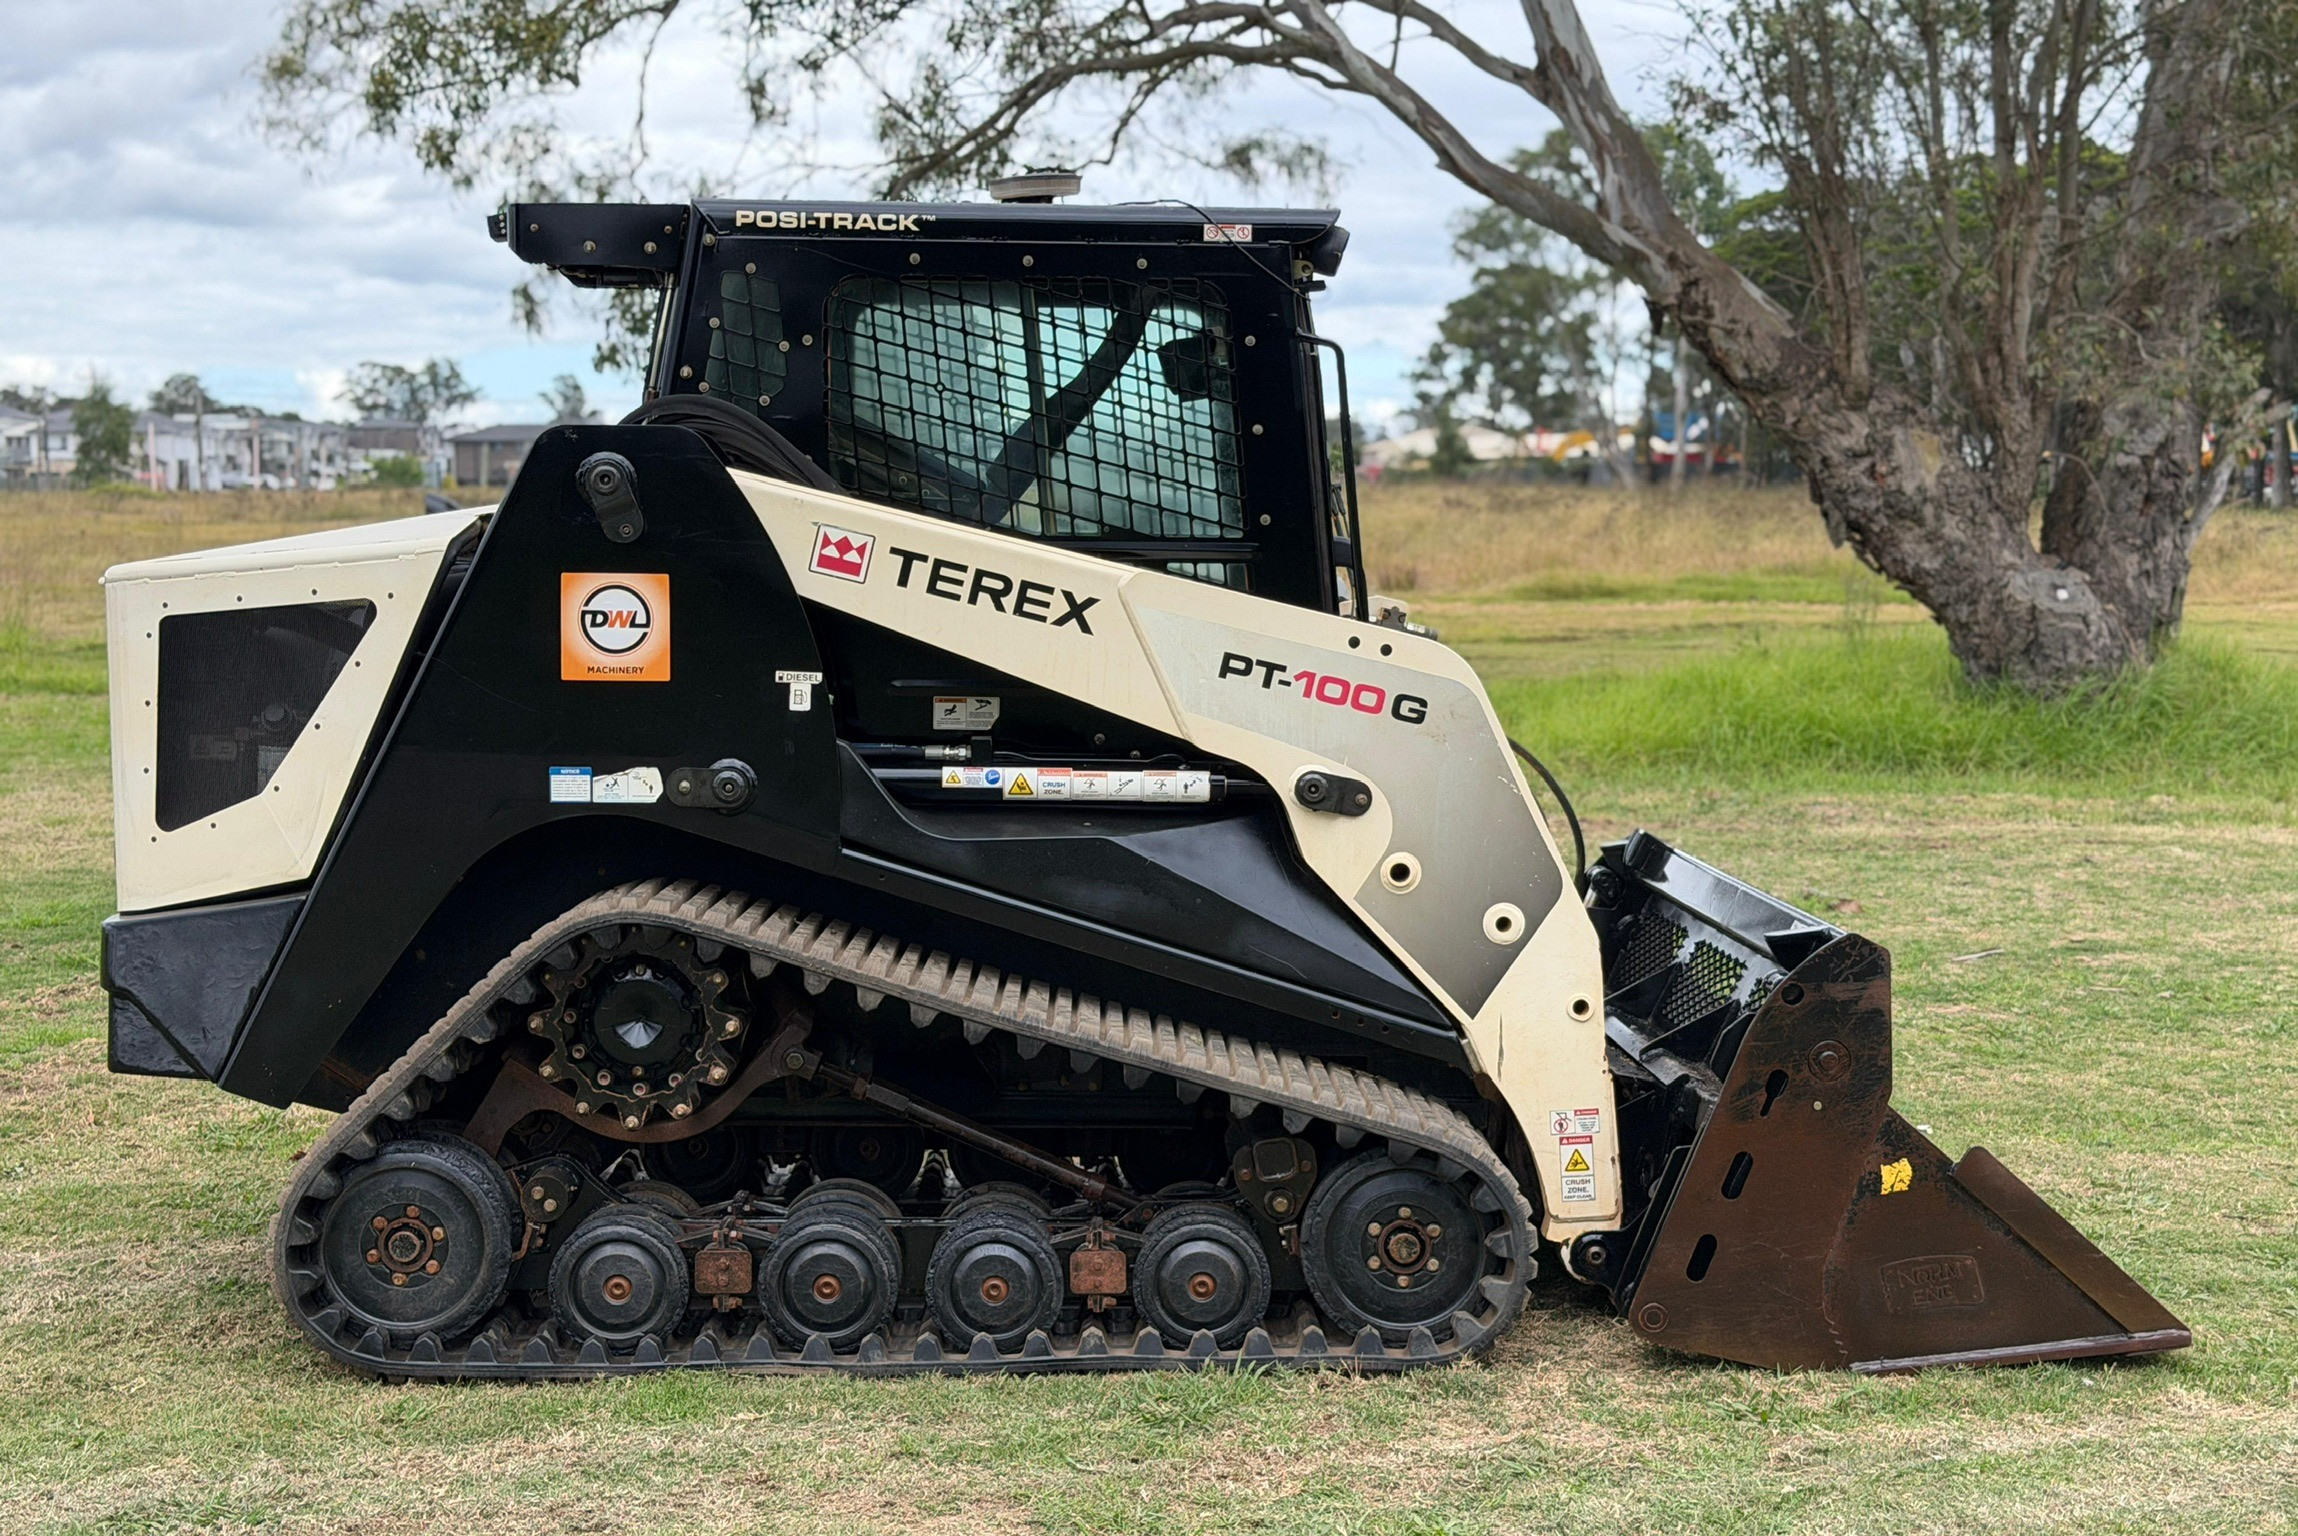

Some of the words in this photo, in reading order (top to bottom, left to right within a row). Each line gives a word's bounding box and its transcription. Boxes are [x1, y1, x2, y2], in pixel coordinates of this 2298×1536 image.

[888, 546, 1101, 636] TEREX
[580, 609, 651, 629] DWL
[587, 665, 645, 675] MACHINERY
[785, 672, 821, 683] DIESEL
